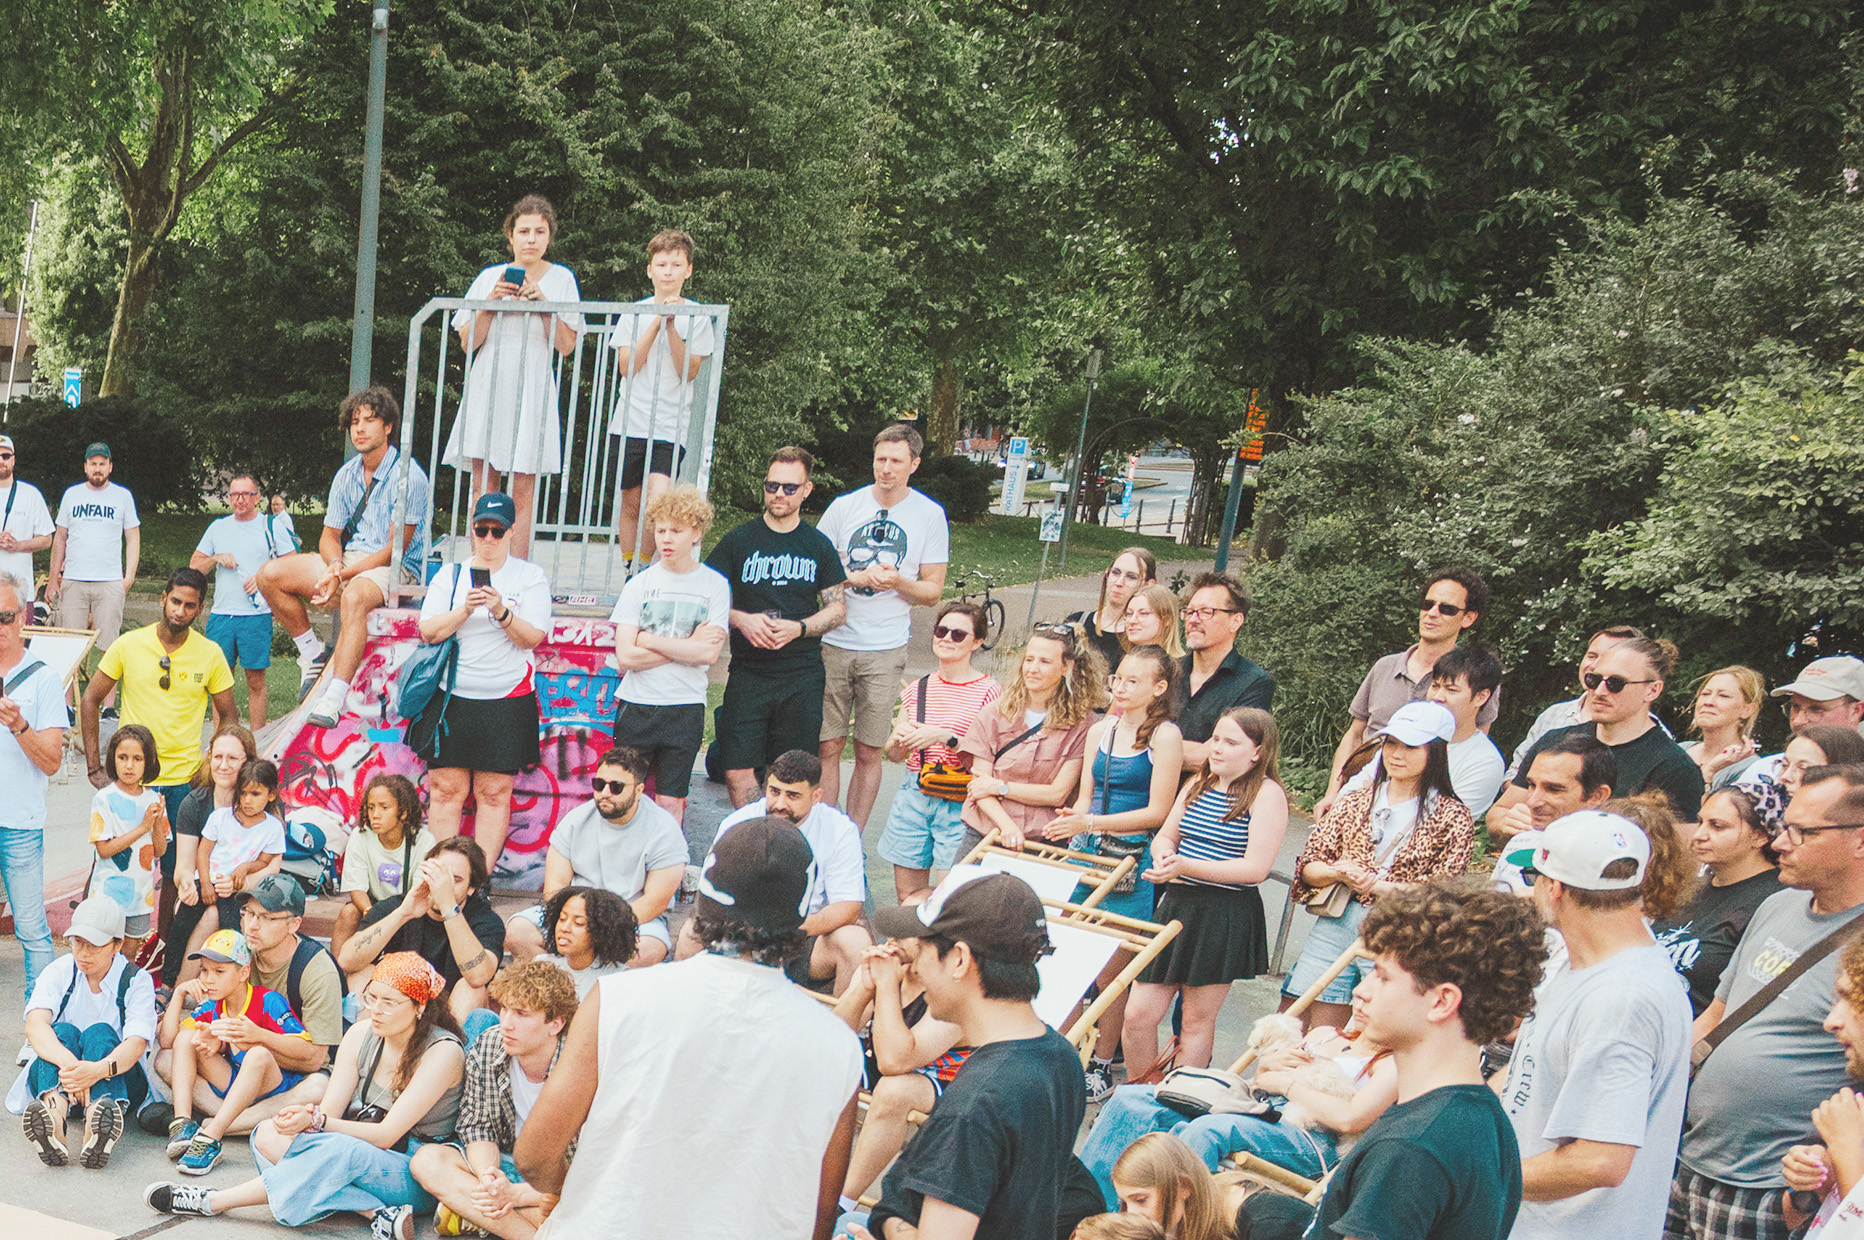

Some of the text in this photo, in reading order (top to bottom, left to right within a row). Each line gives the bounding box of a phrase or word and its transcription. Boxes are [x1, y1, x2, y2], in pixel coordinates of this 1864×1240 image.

[1012, 441, 1023, 453] P
[72, 503, 115, 520] UNFAIR
[741, 550, 817, 585] thrown
[1513, 1055, 1535, 1107] Crew
